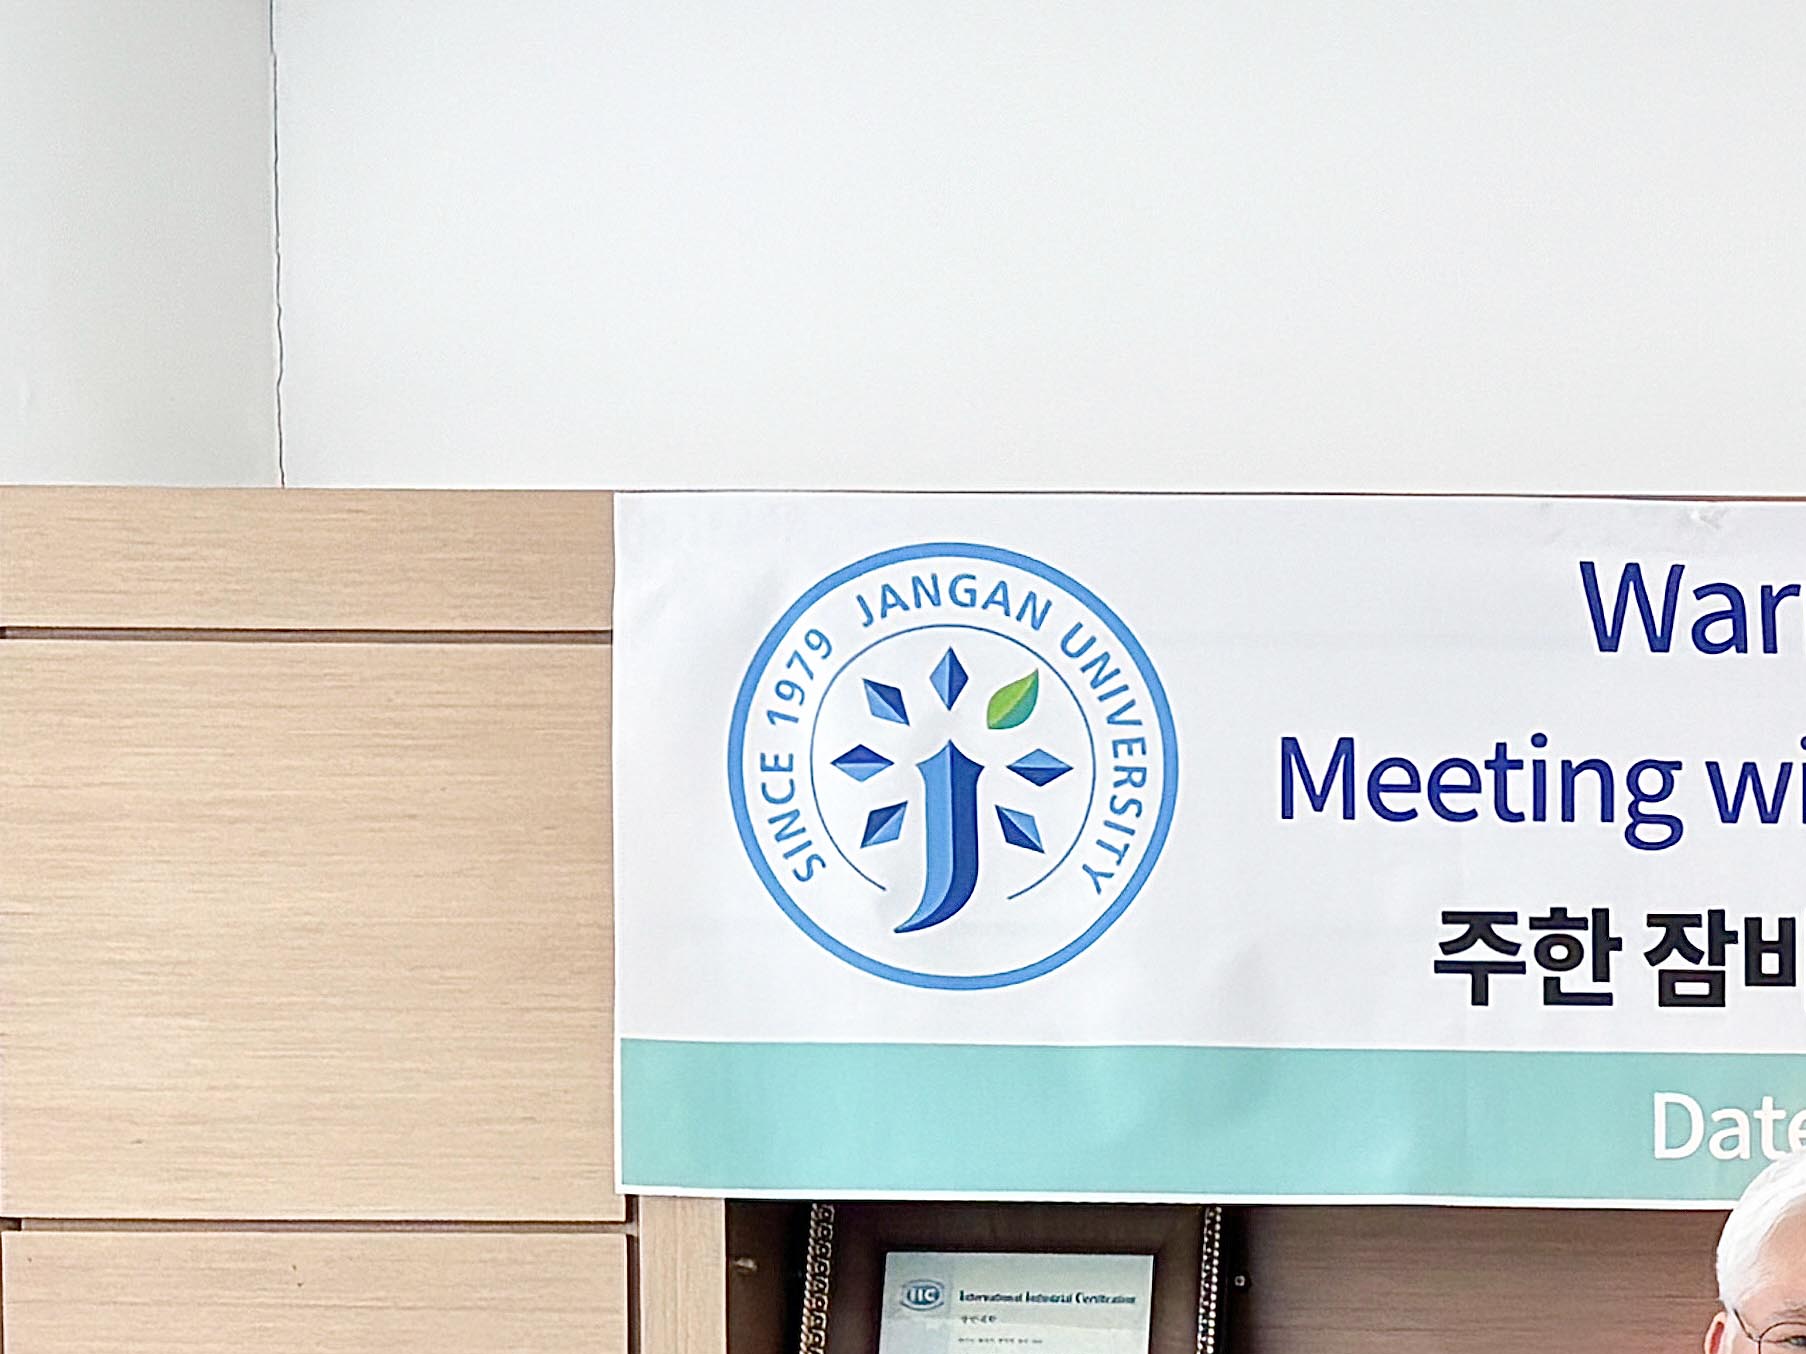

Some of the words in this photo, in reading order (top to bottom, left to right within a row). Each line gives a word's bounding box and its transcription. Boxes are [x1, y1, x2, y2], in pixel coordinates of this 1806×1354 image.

[855, 572, 1053, 632] JANGAN
[766, 627, 834, 727] 1979
[1059, 622, 1148, 896] UNIVERSITY
[1282, 733, 1683, 852] Meeting
[760, 751, 827, 883] SINCE
[1433, 906, 1623, 1007] 주한
